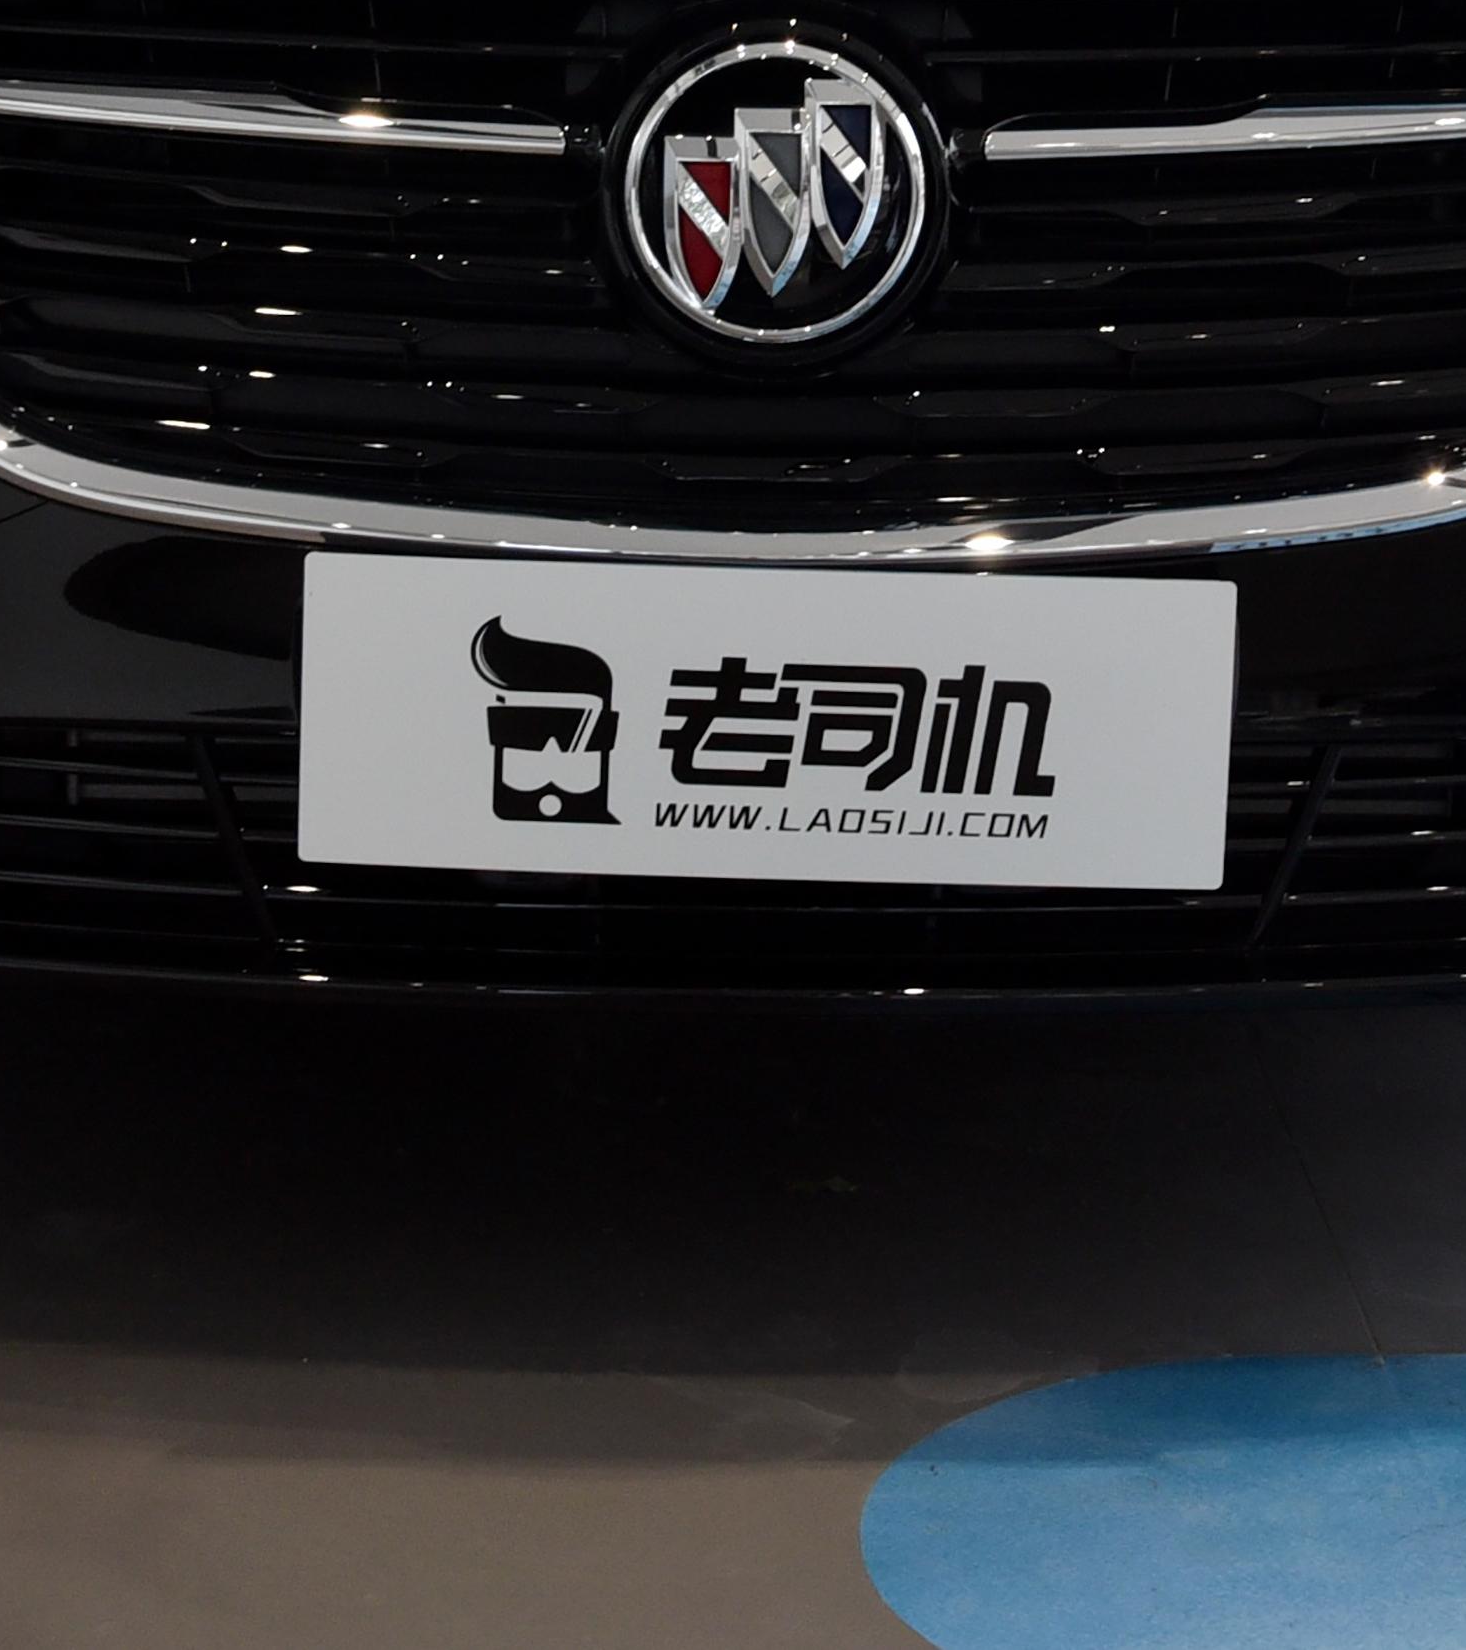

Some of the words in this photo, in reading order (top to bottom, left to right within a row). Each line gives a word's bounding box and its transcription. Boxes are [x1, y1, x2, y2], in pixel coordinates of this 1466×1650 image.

[658, 656, 1056, 797] 老司机
[654, 802, 1050, 840] WWW.LAOSIJI.COM
